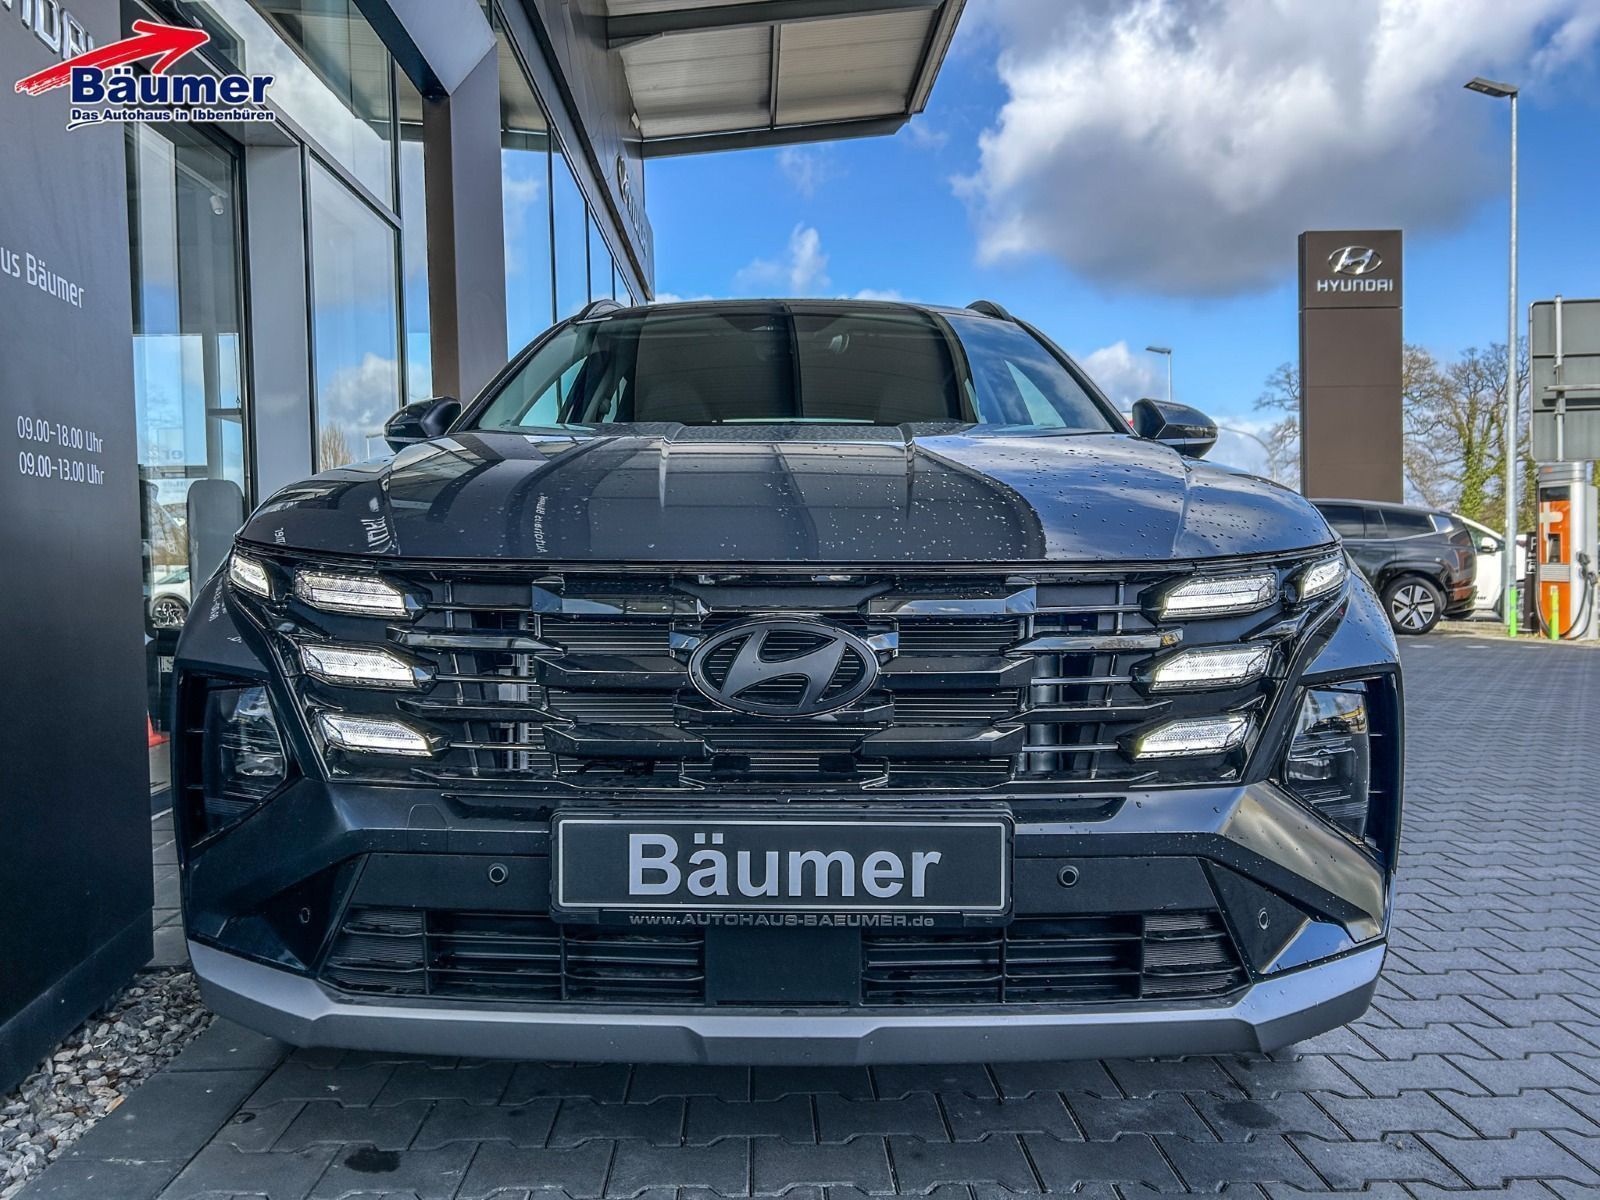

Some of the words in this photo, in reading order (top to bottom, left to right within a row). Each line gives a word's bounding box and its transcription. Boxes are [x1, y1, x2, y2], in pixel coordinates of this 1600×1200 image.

[26, 252, 84, 309] Bäumer
[1317, 279, 1393, 292] HYUNDAI
[85, 430, 104, 453] Uhr
[87, 463, 105, 485] Uhr
[628, 832, 942, 898] Bäumer
[629, 913, 935, 928] www.AUTOHAUS-BAEUMER.de
